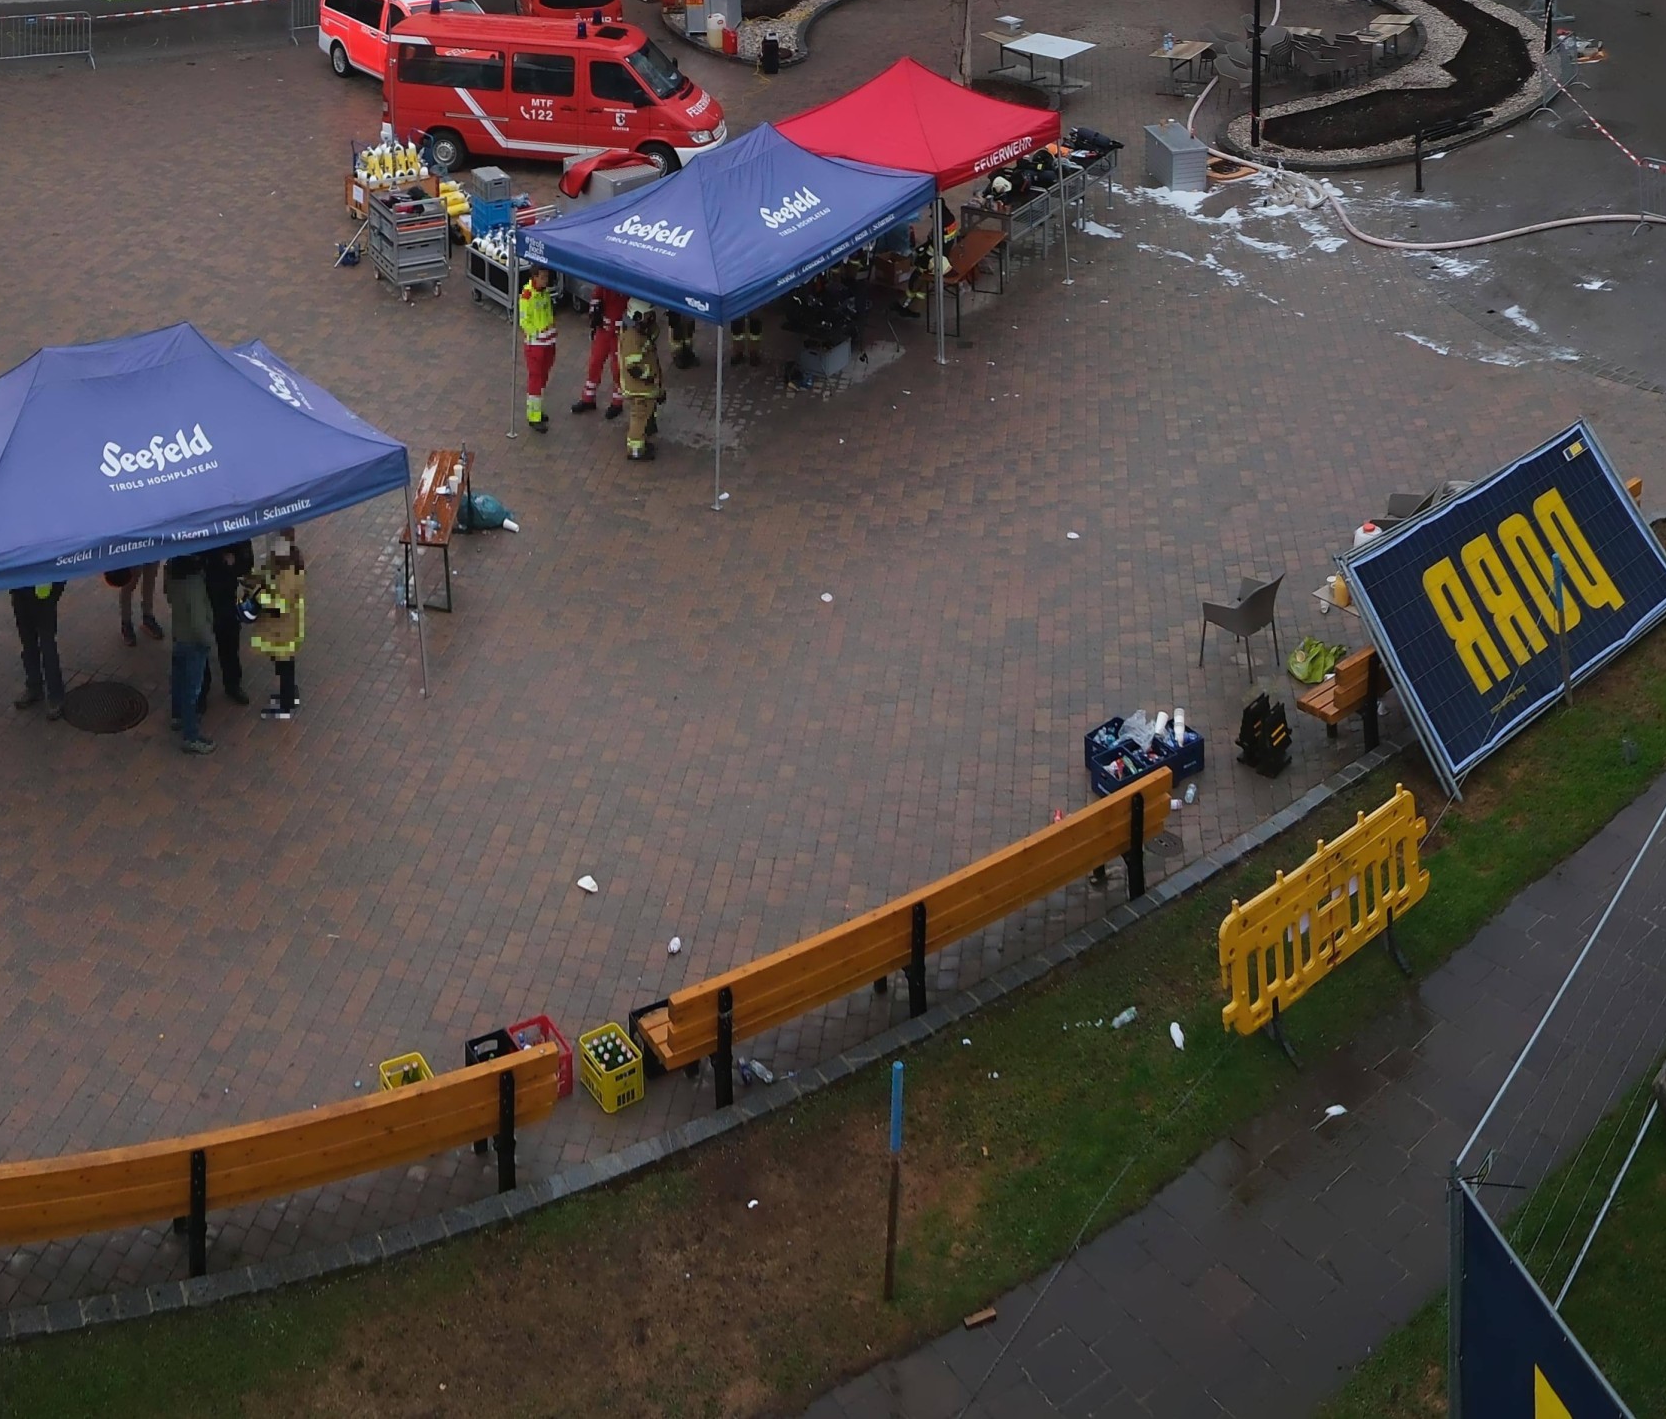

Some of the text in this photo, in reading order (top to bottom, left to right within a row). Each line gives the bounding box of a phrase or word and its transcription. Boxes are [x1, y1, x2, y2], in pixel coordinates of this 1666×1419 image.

[529, 109, 554, 120] 122
[531, 98, 553, 108] MTF
[759, 186, 821, 229] Seefeld
[604, 235, 677, 258] TIROLS HOCHPLATEAU
[613, 214, 694, 249] Seefeld
[99, 423, 213, 477] Seefeld
[108, 460, 219, 492] TIROLS HOCHPLATEAU
[108, 536, 155, 556] Leutasch
[223, 514, 251, 532] Reith
[263, 497, 312, 521] Scharnitz
